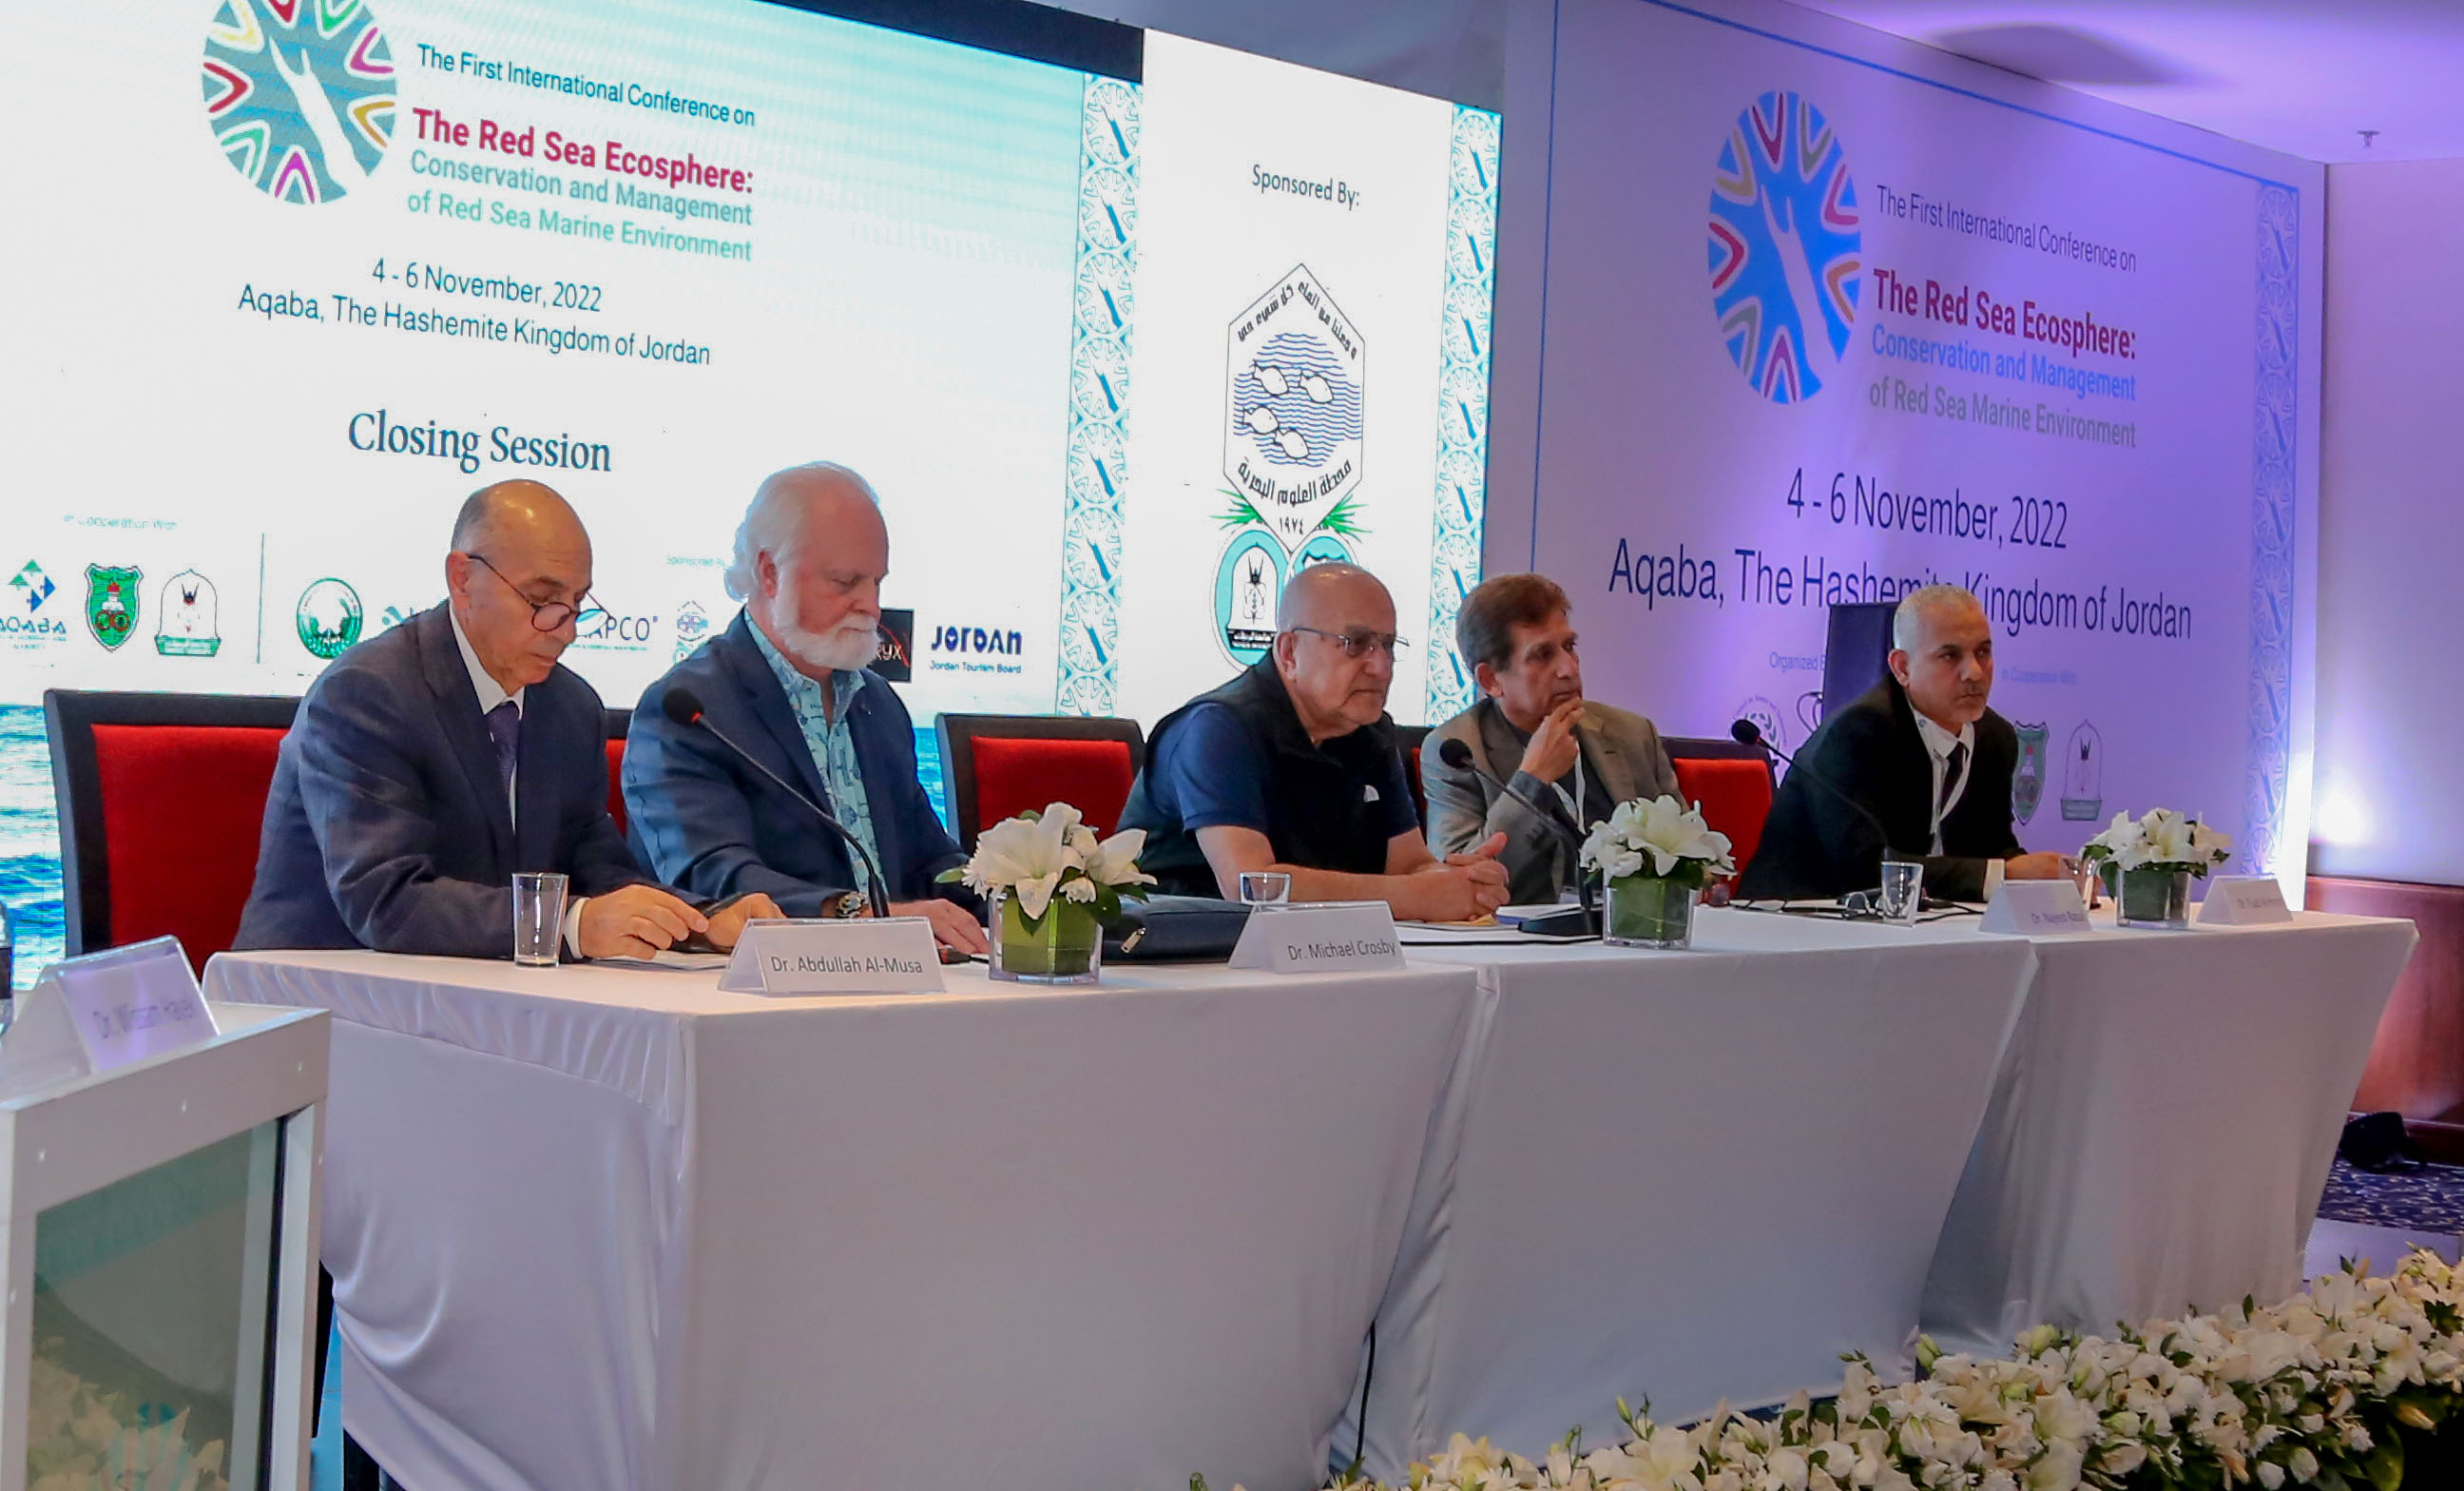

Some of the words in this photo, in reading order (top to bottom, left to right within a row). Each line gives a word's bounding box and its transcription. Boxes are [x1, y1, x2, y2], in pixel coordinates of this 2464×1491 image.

[417, 44, 454, 71] The
[461, 52, 503, 81] First
[509, 61, 623, 103] International
[628, 84, 729, 122] Conference
[734, 109, 754, 126] on
[412, 148, 562, 195] Conservation
[569, 178, 608, 203] and
[615, 182, 752, 225] Management
[413, 107, 470, 146] The
[479, 119, 534, 157] Red
[544, 131, 595, 167] Sea
[606, 141, 754, 193] Ecosphere:
[1252, 165, 1333, 201] Sponsored
[1338, 182, 1359, 211] By:
[408, 190, 432, 213] of
[439, 193, 482, 222] Red
[491, 202, 530, 228] Sea
[539, 208, 614, 242] Marine
[622, 221, 751, 261] Environment
[1877, 184, 1906, 218] The
[1911, 193, 1943, 227] First
[1947, 202, 2035, 248] International
[2039, 225, 2117, 268] Conference
[2120, 252, 2136, 273] on
[372, 258, 385, 282] 4
[406, 262, 418, 288] 6
[425, 264, 546, 308] November,
[552, 281, 601, 312] 2022
[1874, 268, 1917, 316] The
[1925, 280, 1968, 325] Red
[1975, 291, 2015, 336] Sea
[2024, 301, 2135, 359] Ecosphere:
[238, 284, 323, 322] Aqaba,
[333, 295, 376, 325] The
[384, 301, 508, 341] Hashemite
[514, 318, 609, 354] Kingdom
[615, 333, 635, 356] of
[640, 335, 709, 365] Jordan
[1873, 323, 1990, 375] Conservation
[1995, 350, 2027, 380] and
[2031, 354, 2136, 401] Management
[349, 409, 481, 474] Closing
[491, 427, 610, 472] Session
[1870, 375, 1891, 408] of
[1894, 378, 1928, 414] Red
[1935, 385, 1967, 420] Sea
[1973, 393, 2031, 431] Marine
[2036, 403, 2136, 449] Environment
[1787, 468, 1804, 517] 4
[1831, 473, 1845, 523] 6
[1856, 475, 2002, 549] November,
[2011, 496, 2067, 548] 2022
[1608, 538, 1723, 610] Aqaba,
[1735, 549, 1792, 605] The
[1802, 555, 1953, 608] Hashem
[2085, 586, 2107, 630] of
[2112, 588, 2190, 639] Jordan
[930, 660, 959, 670] Jordan
[962, 662, 994, 671] Tourism
[997, 664, 1021, 673] Board
[771, 957, 794, 972] Dr.
[799, 956, 861, 972] Abdullah
[866, 957, 922, 973] Al-Musa
[1288, 945, 1307, 960] Dr.
[1308, 941, 1356, 958] Michael
[1357, 939, 1395, 956] Crosby
